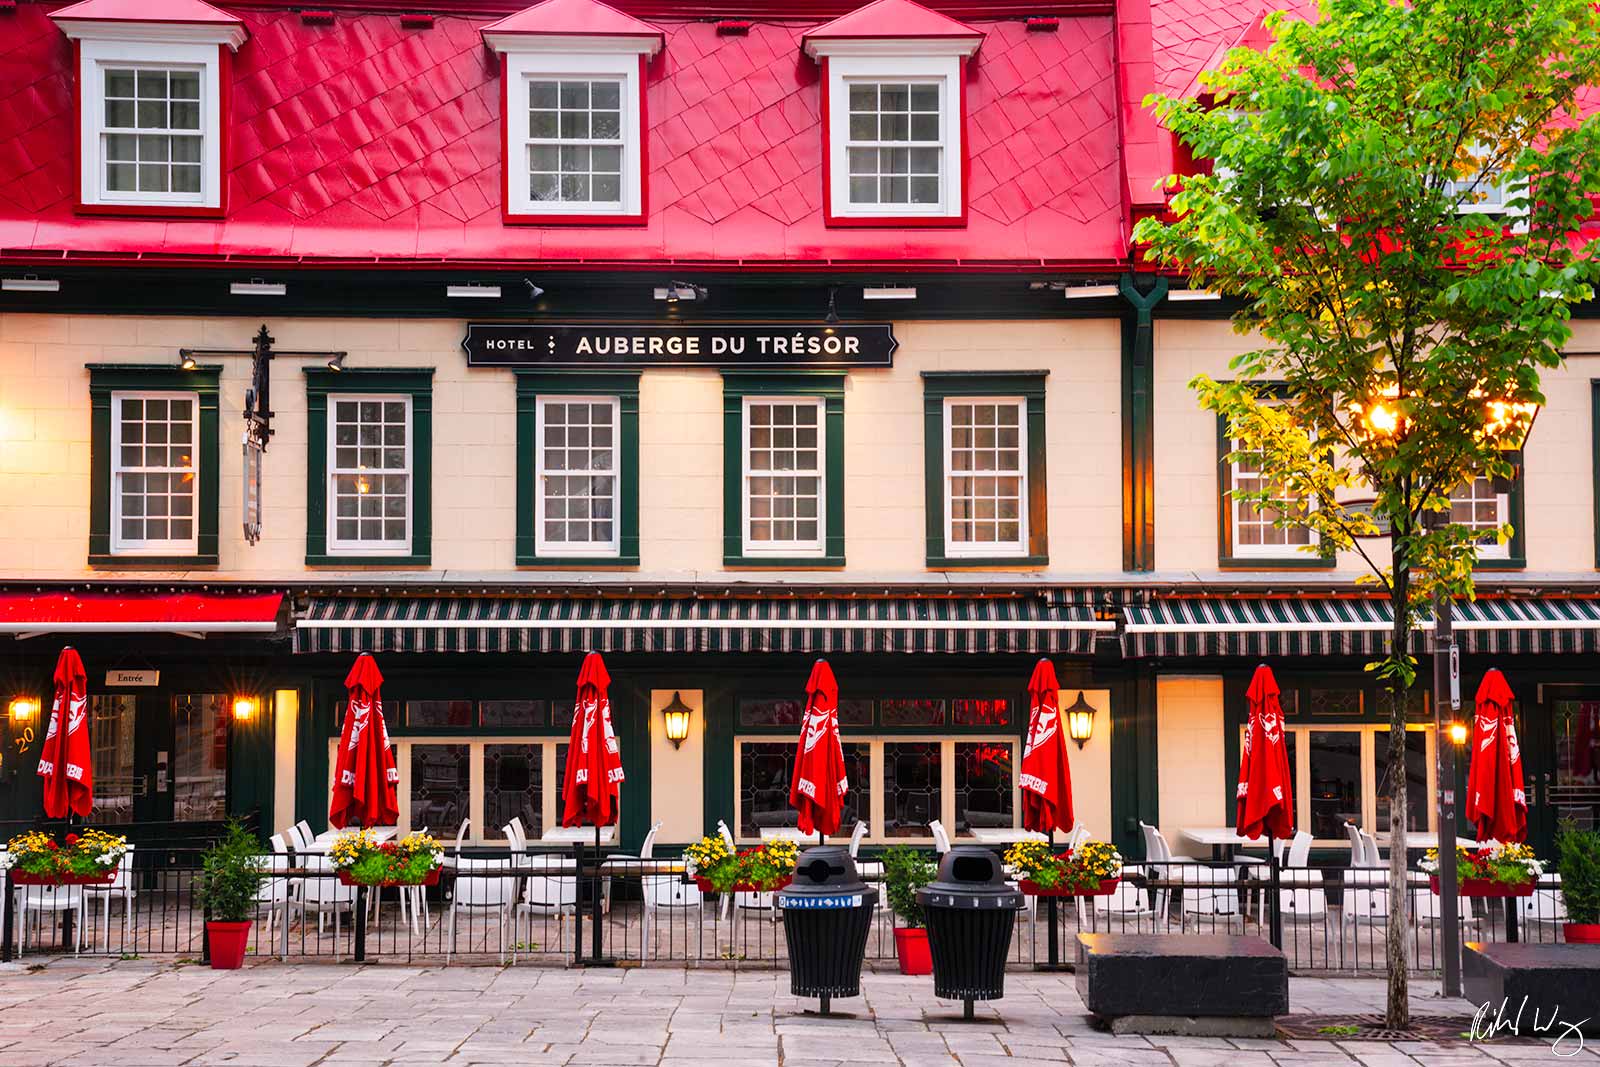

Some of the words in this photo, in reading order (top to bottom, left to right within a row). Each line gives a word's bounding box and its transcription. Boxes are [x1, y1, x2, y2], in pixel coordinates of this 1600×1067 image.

[486, 339, 535, 350] HOTEL
[575, 336, 701, 355] AUBERGE
[711, 336, 746, 355] DU
[756, 332, 861, 355] TRÉSOR
[118, 672, 144, 682] Entrée
[15, 727, 35, 754] 20
